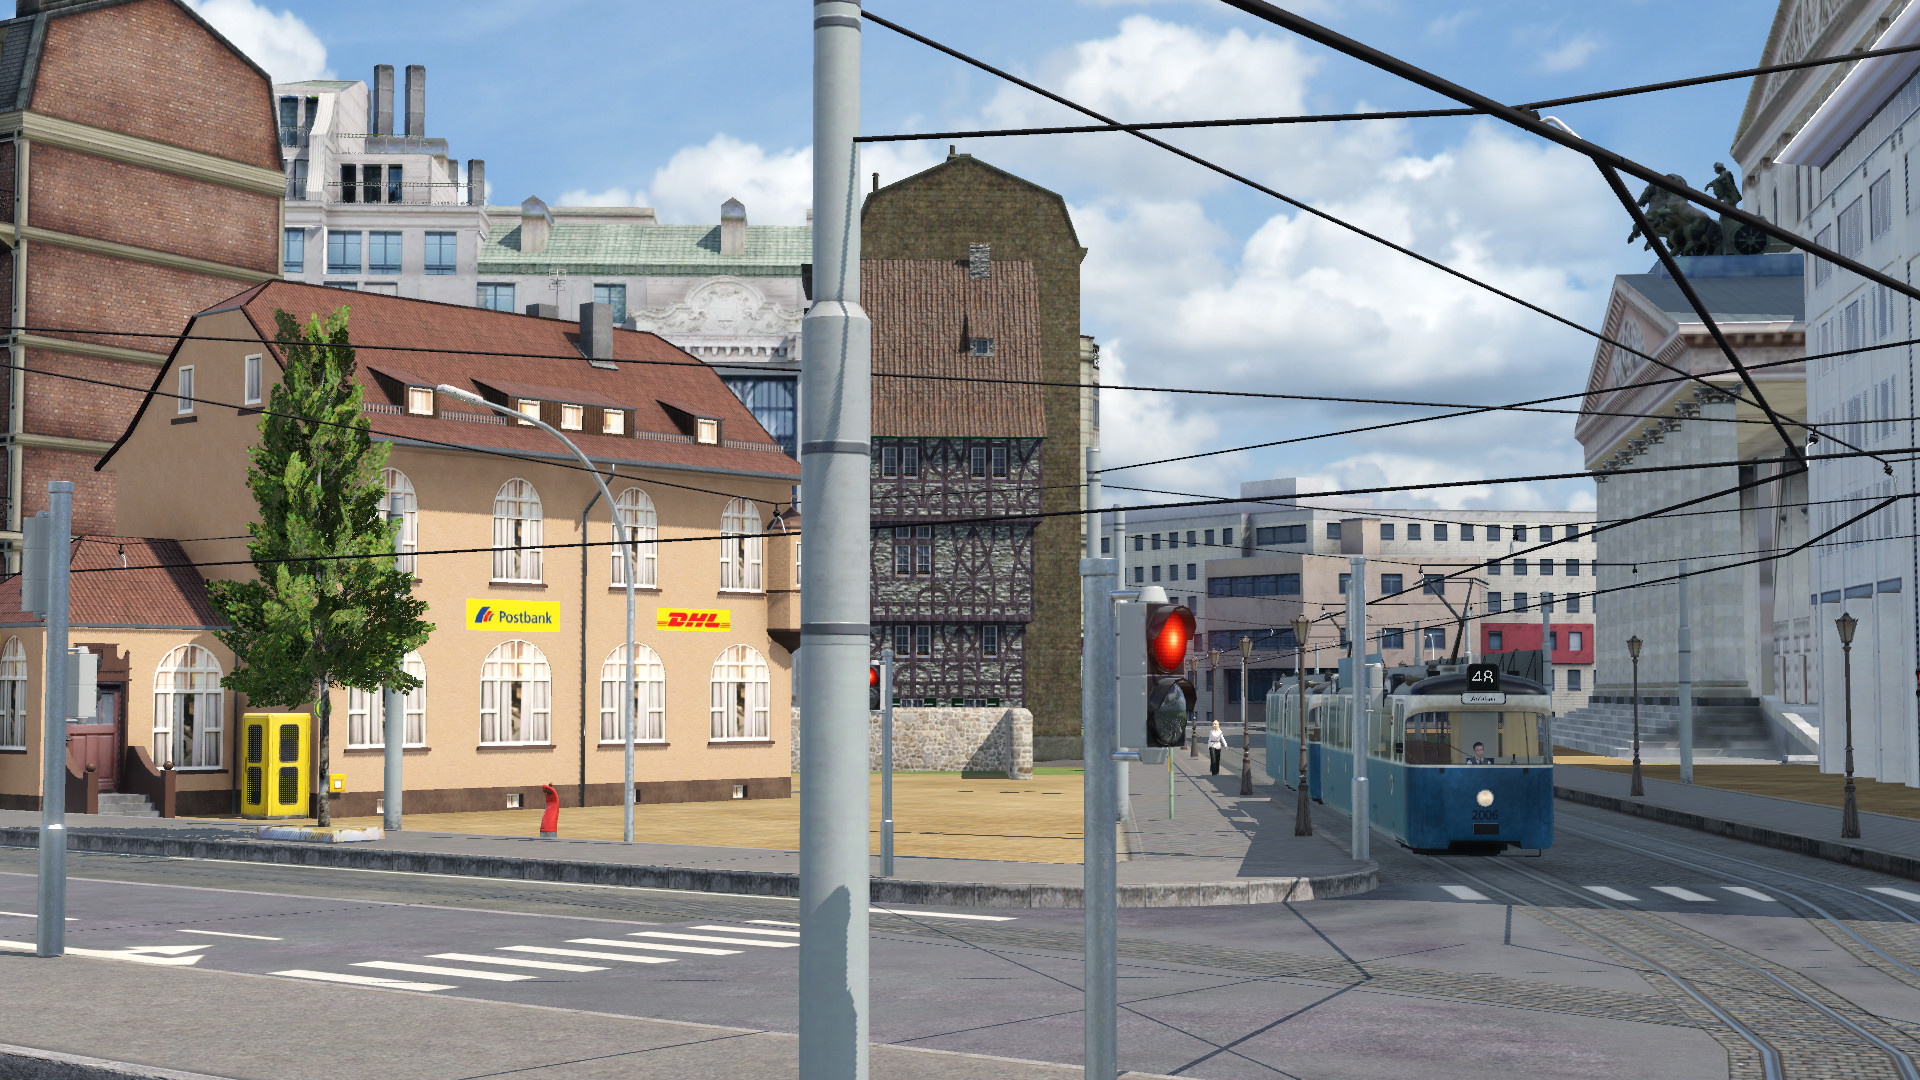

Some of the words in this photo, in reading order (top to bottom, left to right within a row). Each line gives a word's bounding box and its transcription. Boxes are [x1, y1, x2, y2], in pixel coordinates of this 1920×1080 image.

[499, 610, 552, 625] Postbank
[668, 612, 721, 628] DHL
[1471, 669, 1494, 684] 48
[1472, 809, 1499, 821] 2006
